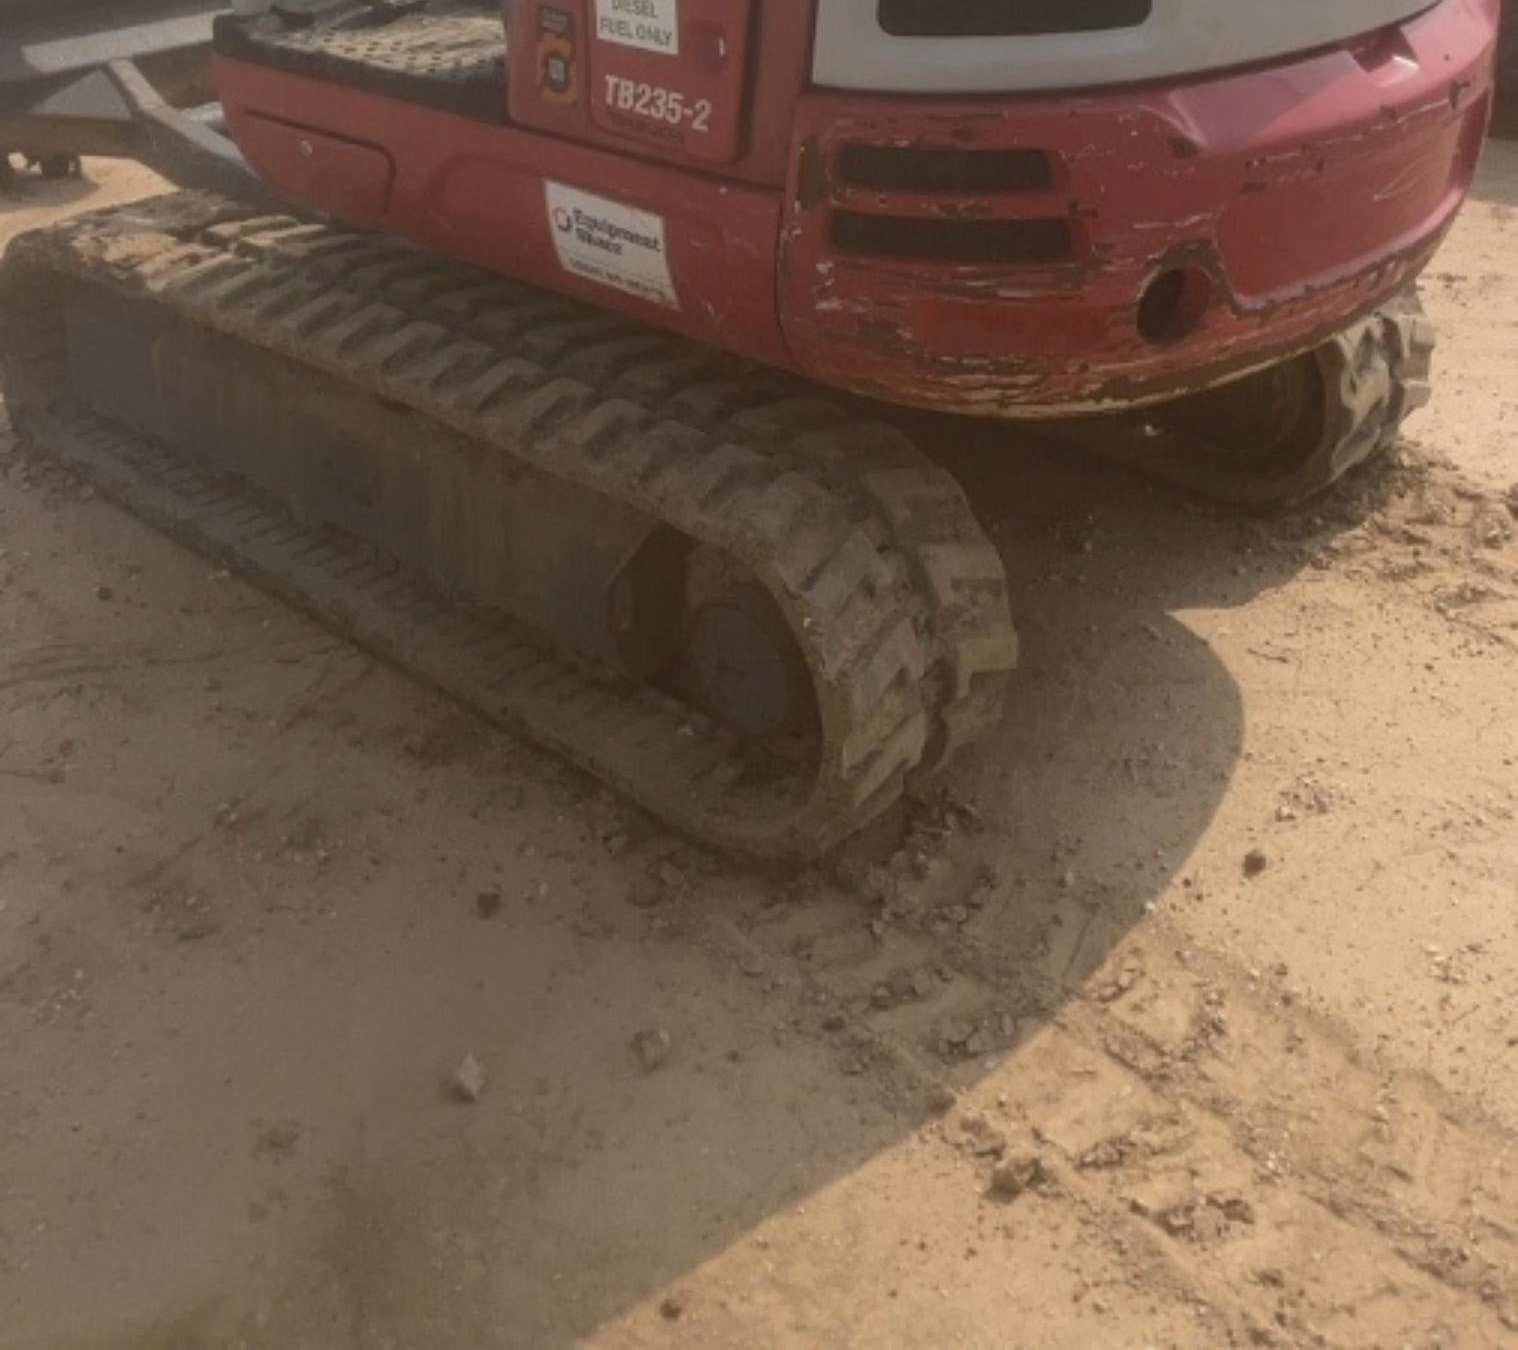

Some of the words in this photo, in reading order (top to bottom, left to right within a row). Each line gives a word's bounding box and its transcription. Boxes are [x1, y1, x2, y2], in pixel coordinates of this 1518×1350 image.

[600, 17, 633, 40] FUEL
[635, 23, 673, 47] ONLY
[604, 73, 713, 133] TB235-2
